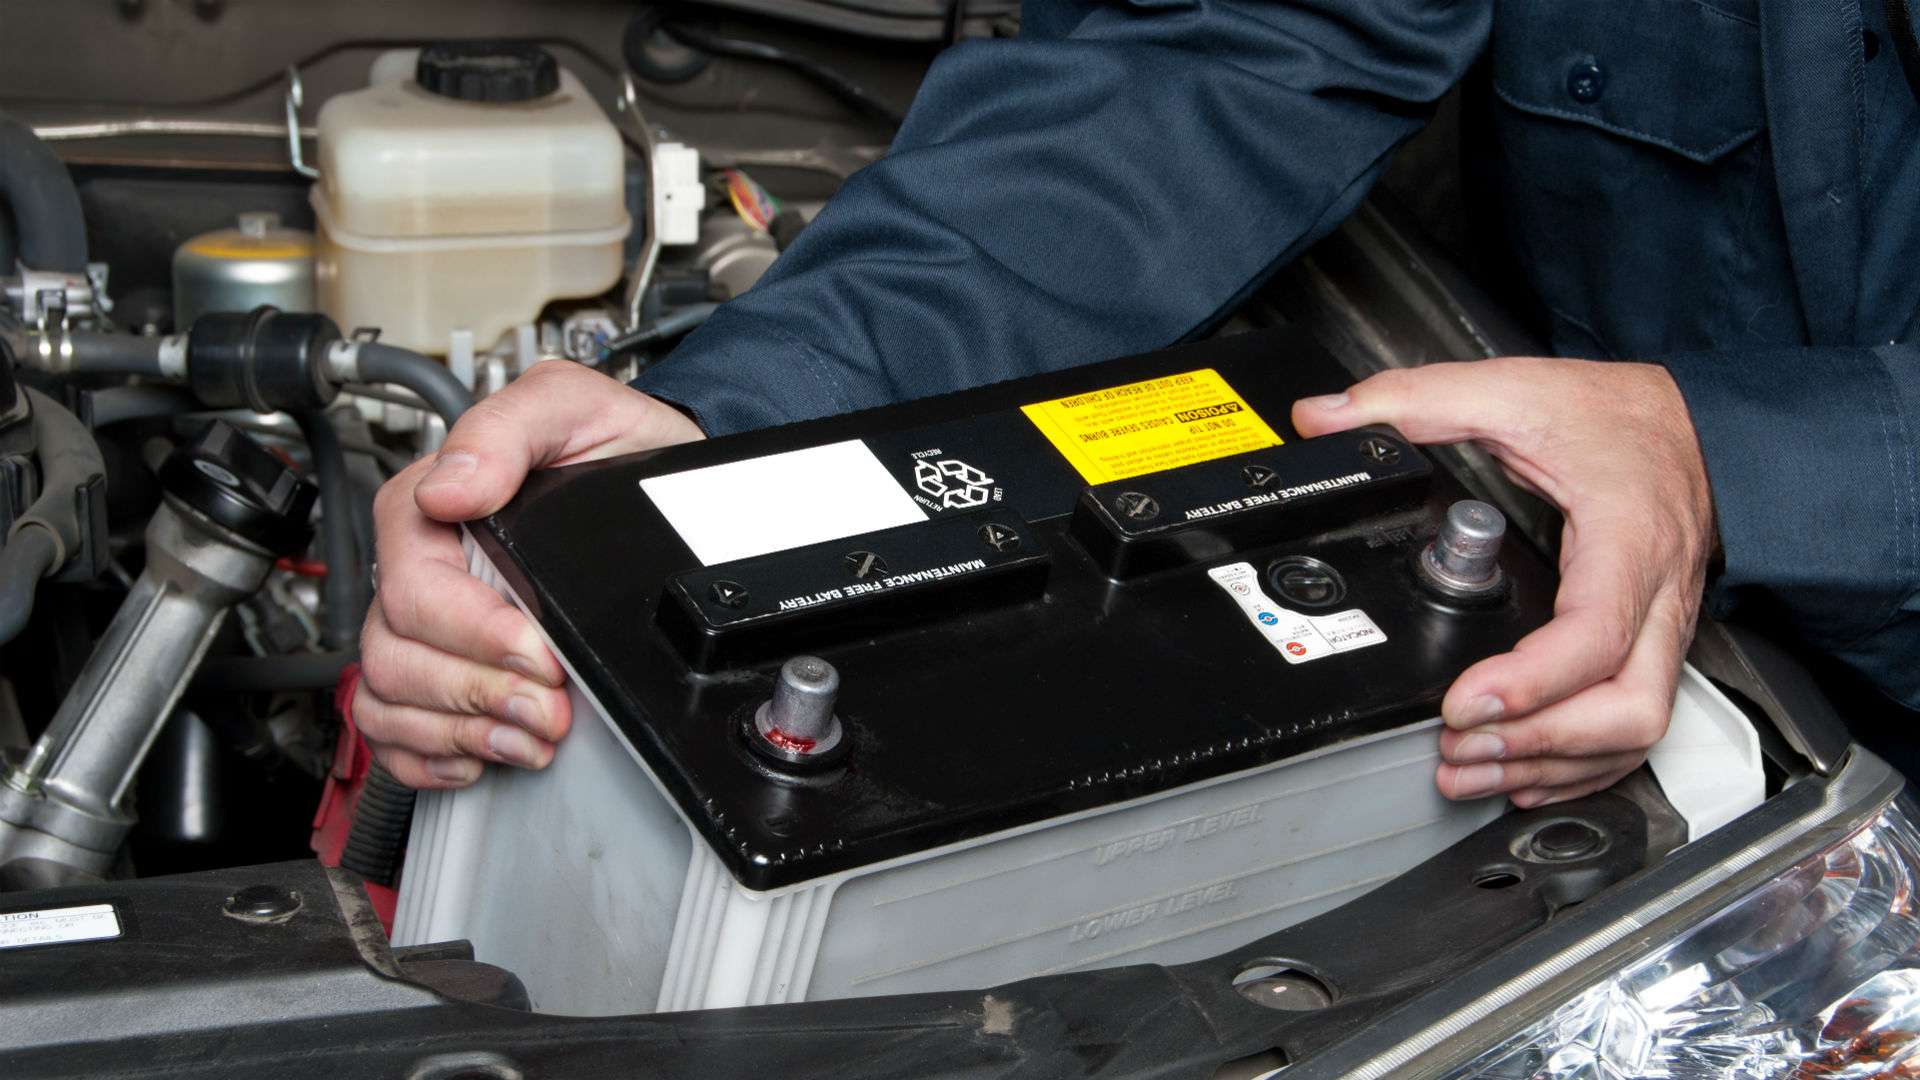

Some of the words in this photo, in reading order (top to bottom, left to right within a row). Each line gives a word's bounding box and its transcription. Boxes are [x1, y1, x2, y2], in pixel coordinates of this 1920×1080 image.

[1103, 389, 1115, 400] OF
[1117, 384, 1142, 398] REACH
[1060, 392, 1102, 409] CHILDREN
[1178, 405, 1227, 423] POISON
[1113, 422, 1141, 437] SEVERE
[1143, 416, 1174, 430] CAUSES
[1190, 424, 1204, 435] TIP
[1205, 421, 1223, 432] NOT
[1225, 418, 1237, 428] DO
[1079, 429, 1112, 443] BURNS
[911, 448, 943, 459] RECYCLE
[1281, 471, 1372, 499] MAINTENANCE
[914, 494, 943, 512] RETURN
[1242, 491, 1280, 508] FREE
[1185, 500, 1242, 521] BATTERY
[883, 558, 987, 588] MAINTENANCE
[843, 580, 883, 598] FREE
[778, 588, 844, 612] BATTERY
[1330, 627, 1376, 646] INDICATOR
[1095, 827, 1177, 867] UPPER
[1184, 805, 1264, 843] LEVEL
[1069, 903, 1162, 944] LOWER
[1163, 881, 1240, 918] LEVEL
